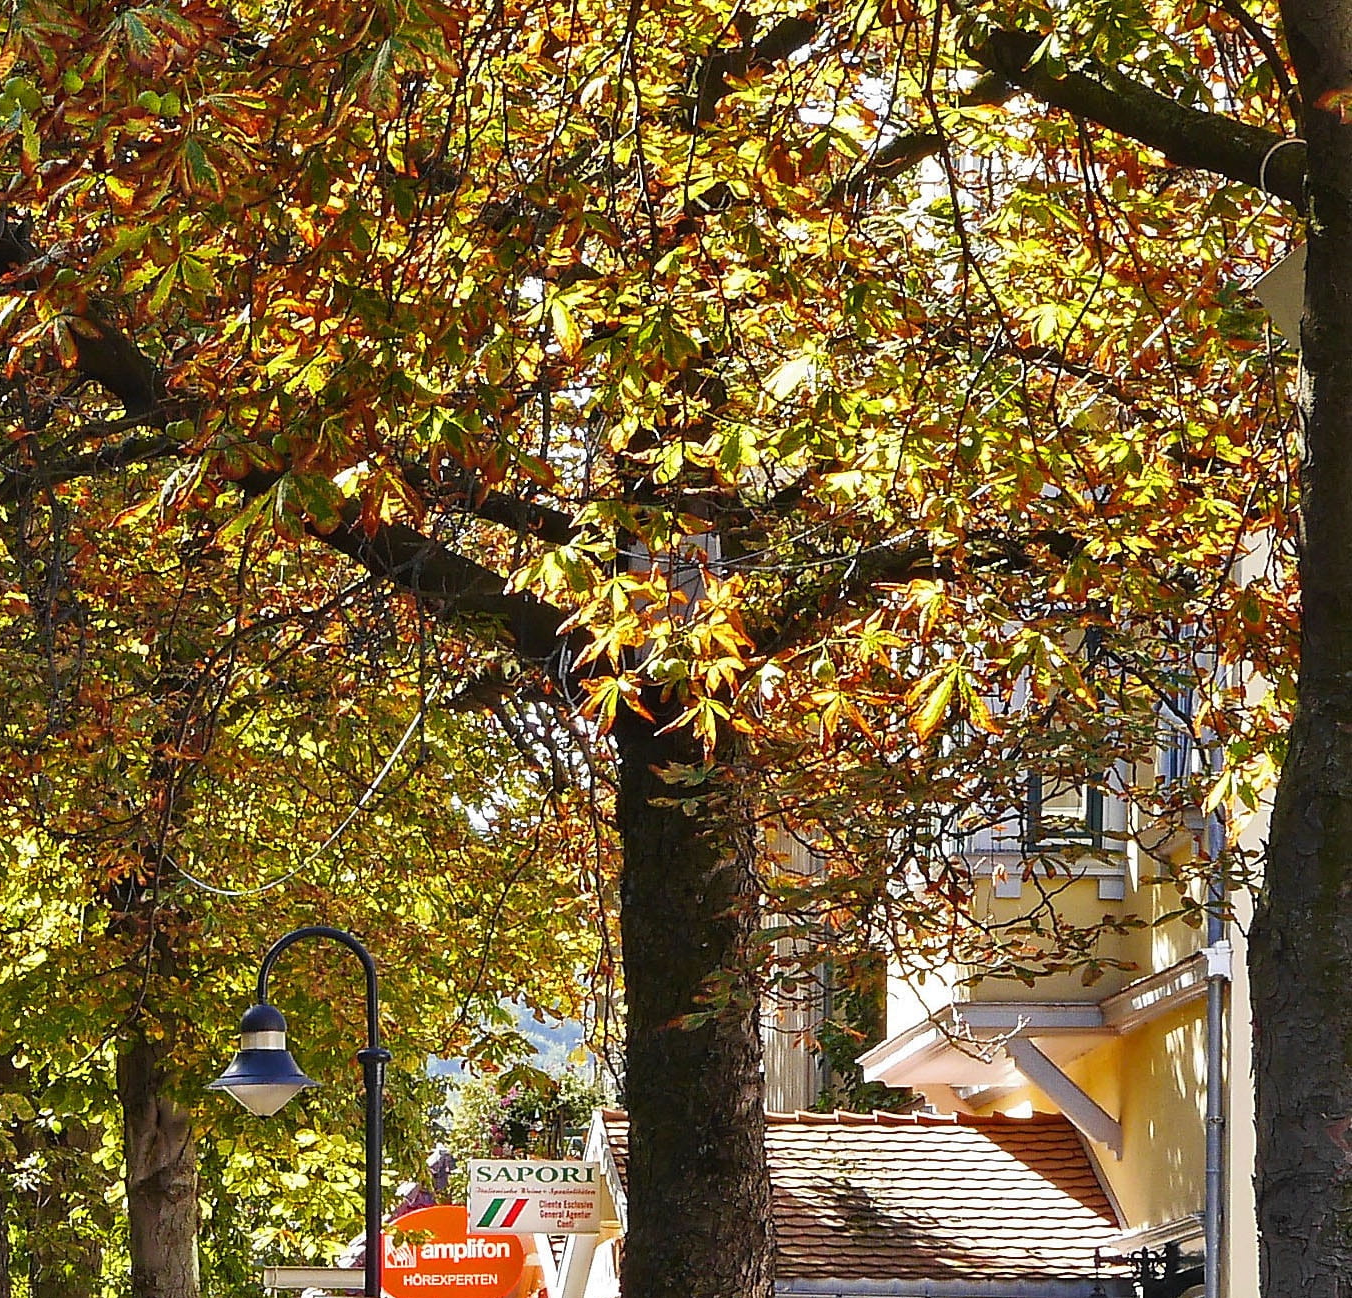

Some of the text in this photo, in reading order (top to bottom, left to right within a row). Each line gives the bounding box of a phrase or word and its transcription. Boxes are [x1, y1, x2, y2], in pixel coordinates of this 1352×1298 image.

[476, 1166, 594, 1183] SAPORI
[420, 1238, 510, 1263] amplifon
[403, 1273, 498, 1286] HÖREXPERTEN
